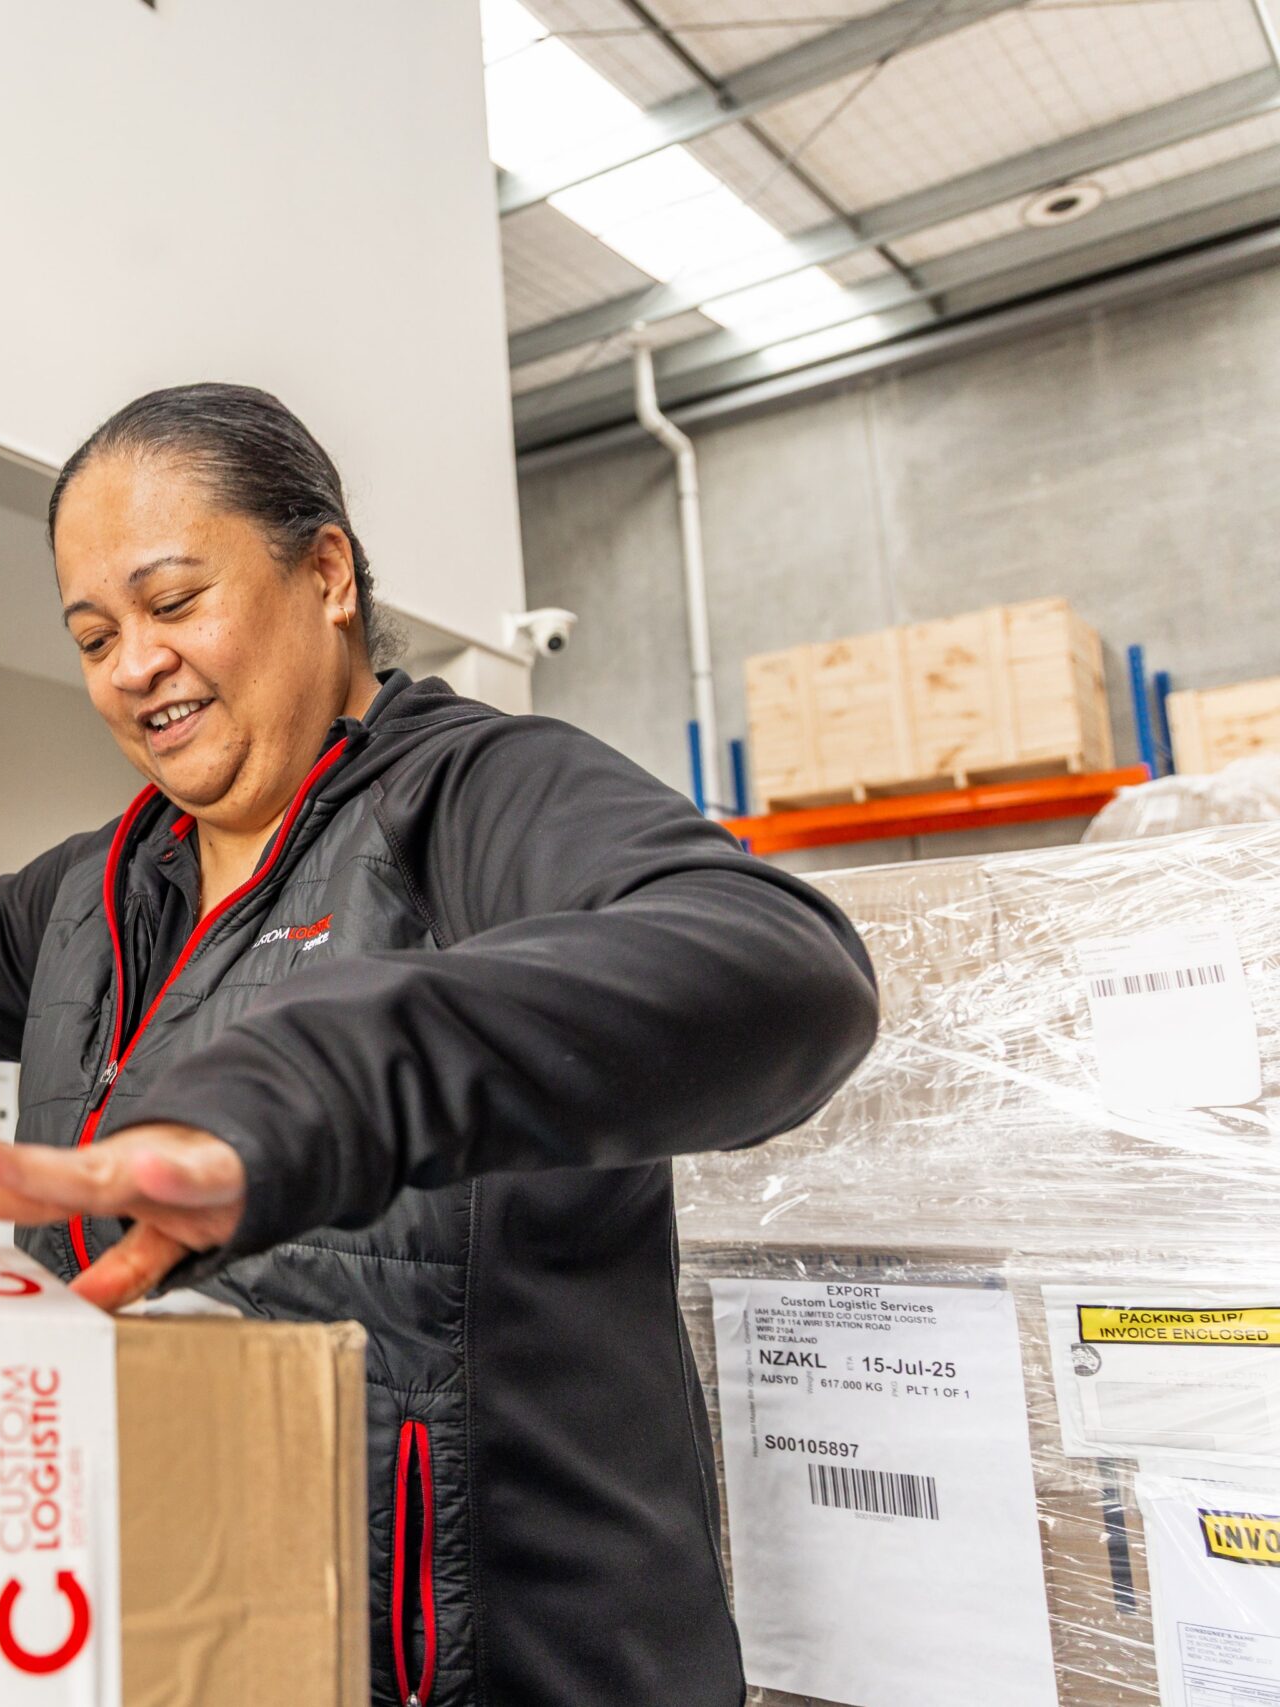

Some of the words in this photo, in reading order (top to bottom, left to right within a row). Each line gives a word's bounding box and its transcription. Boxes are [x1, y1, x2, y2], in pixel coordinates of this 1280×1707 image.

[827, 1285, 881, 1298] EXPORT
[781, 1296, 825, 1308] Custom
[829, 1299, 877, 1311] Logistic
[881, 1301, 934, 1313] Services
[771, 1309, 797, 1317] SALES
[800, 1311, 834, 1319] LIMITED
[854, 1313, 892, 1321] CUSTOM
[895, 1315, 937, 1324] LOGISTIC
[1120, 1313, 1194, 1324] PACKING
[1199, 1313, 1244, 1323] SLIP/
[825, 1320, 863, 1329] STATION
[865, 1323, 891, 1331] ROAD
[778, 1335, 818, 1344] ZEALAND
[1100, 1327, 1167, 1339] INVOICE
[1172, 1328, 1269, 1341] ENCLOSED
[759, 1349, 828, 1369] NZAKL
[862, 1357, 956, 1378] 15-Jul-25
[760, 1374, 799, 1385] AUSYD
[821, 1378, 862, 1390] 617.000
[865, 1382, 883, 1392] KG
[907, 1385, 929, 1396] PLT
[933, 1388, 939, 1397] 1
[943, 1387, 960, 1398] OF
[964, 1390, 970, 1399] 1
[765, 1434, 859, 1458] S00105897
[30, 1367, 62, 1551] LOGISTIC
